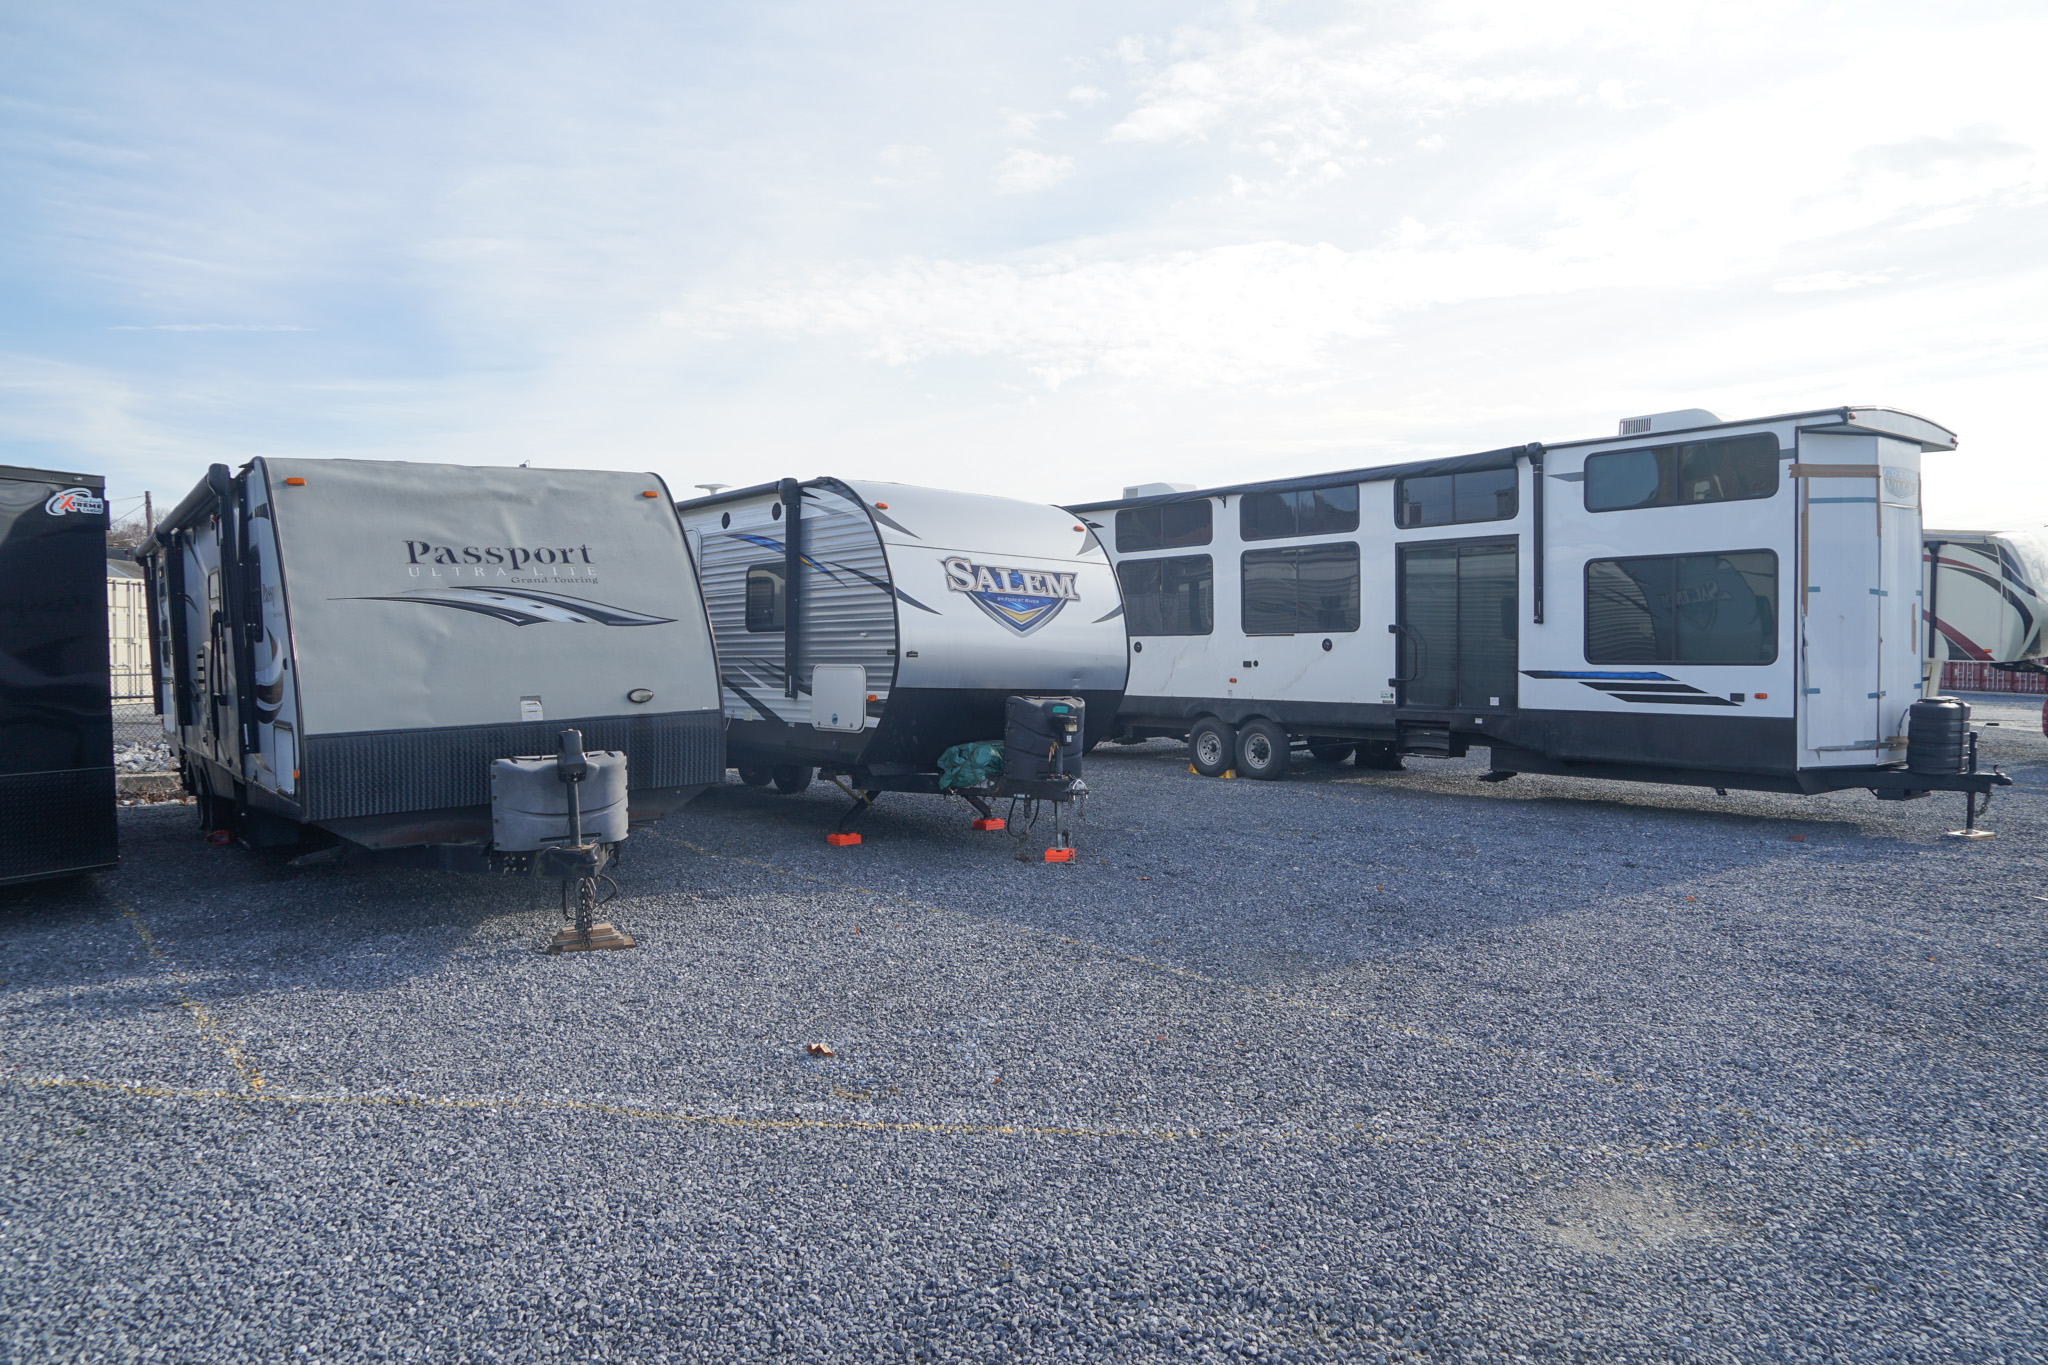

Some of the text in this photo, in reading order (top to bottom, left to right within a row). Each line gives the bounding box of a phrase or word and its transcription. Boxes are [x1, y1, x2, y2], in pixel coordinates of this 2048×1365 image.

[59, 494, 102, 511] XTREME
[402, 540, 596, 571] Passport
[408, 567, 597, 578] ULTRA LITE
[551, 577, 599, 585] Touring
[945, 558, 1080, 600] SALEM
